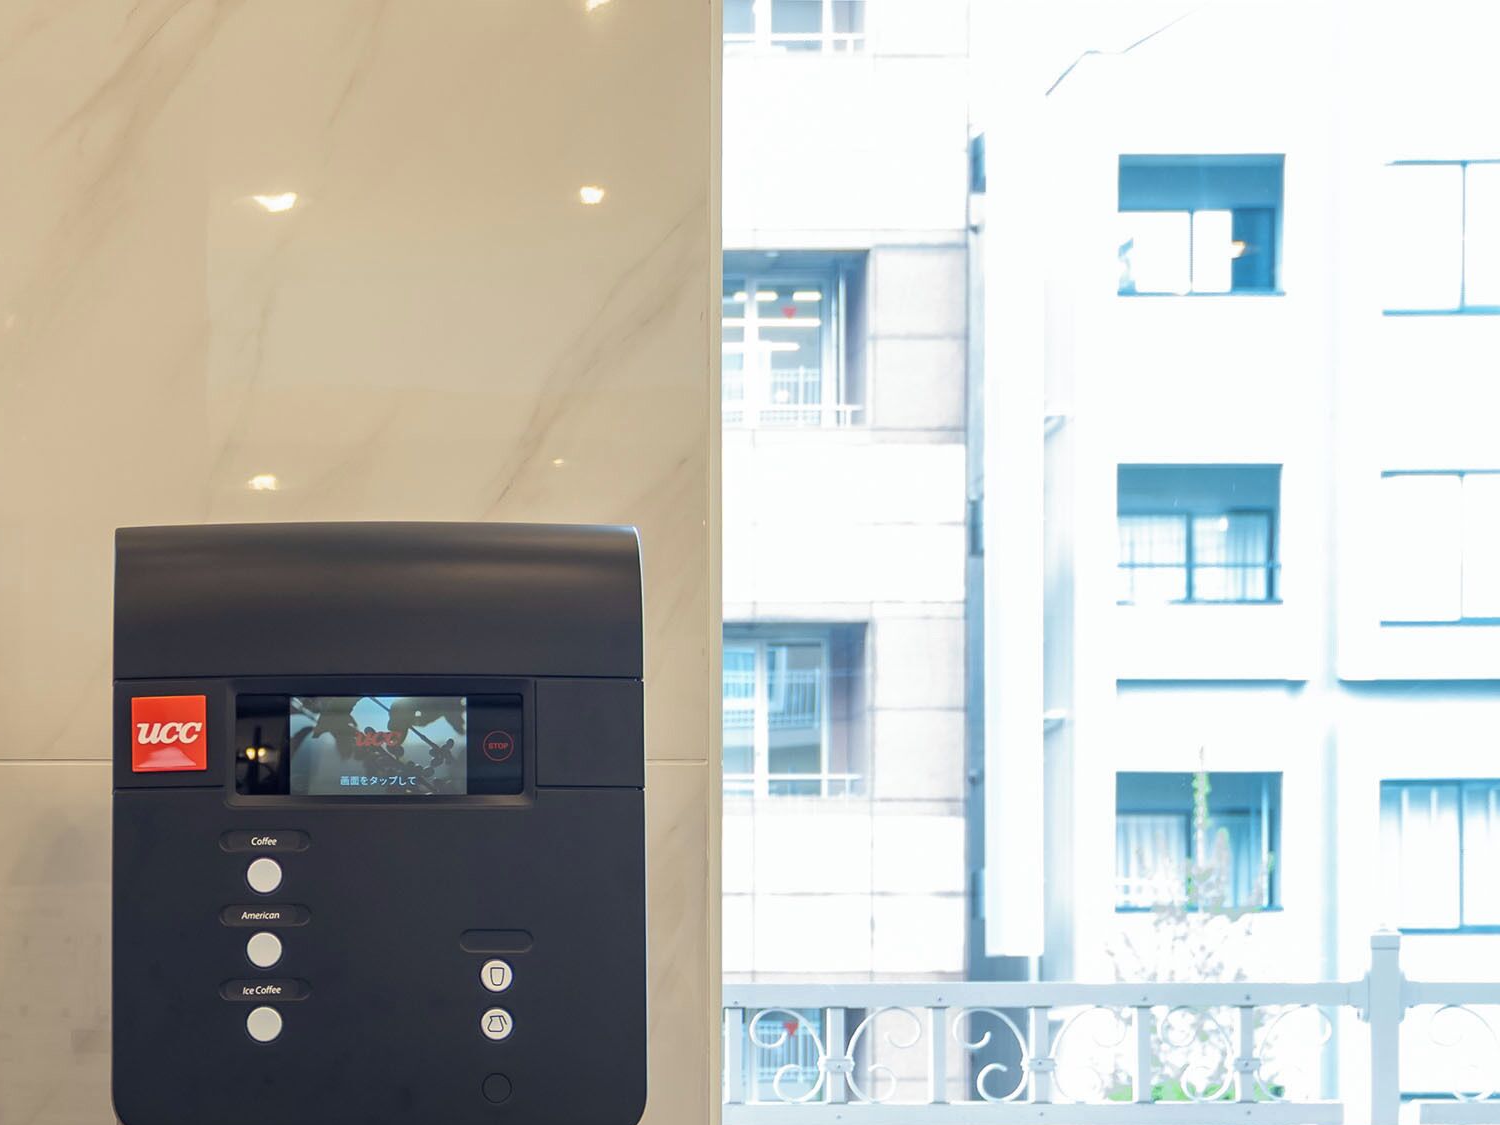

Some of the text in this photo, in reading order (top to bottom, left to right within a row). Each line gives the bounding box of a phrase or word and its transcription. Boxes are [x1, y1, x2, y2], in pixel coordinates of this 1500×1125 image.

[488, 742, 509, 750] STOP
[251, 837, 277, 846] Coffee
[241, 911, 280, 920] American
[243, 985, 282, 995] Ice Coffee
